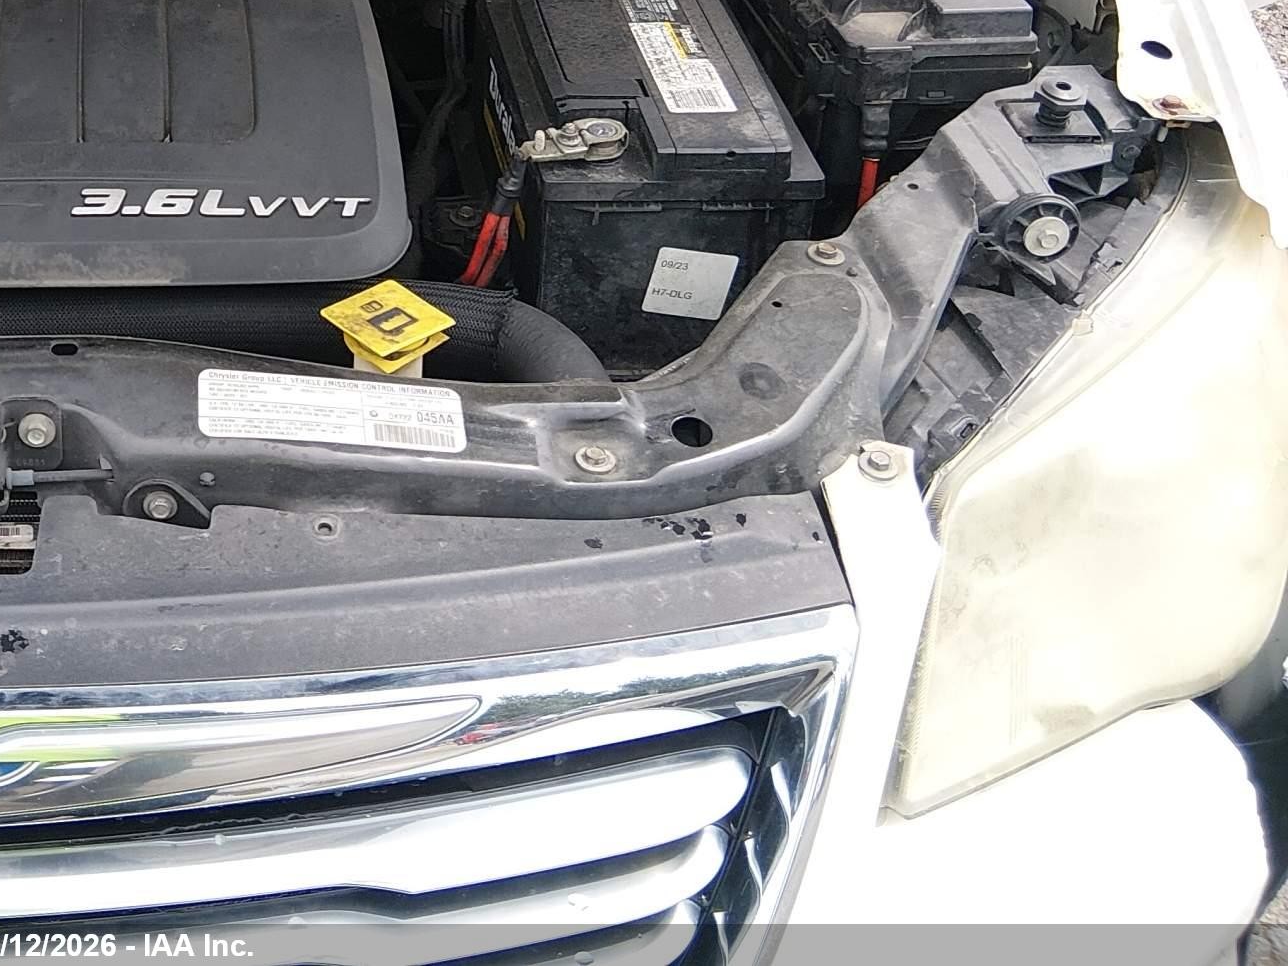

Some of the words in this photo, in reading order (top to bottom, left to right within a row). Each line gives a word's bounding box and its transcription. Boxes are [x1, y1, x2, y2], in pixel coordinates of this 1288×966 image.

[660, 259, 689, 271] 09/23
[651, 287, 693, 300] H7-DLG
[361, 383, 396, 394] CONTROL
[398, 386, 451, 398] INFORMATION
